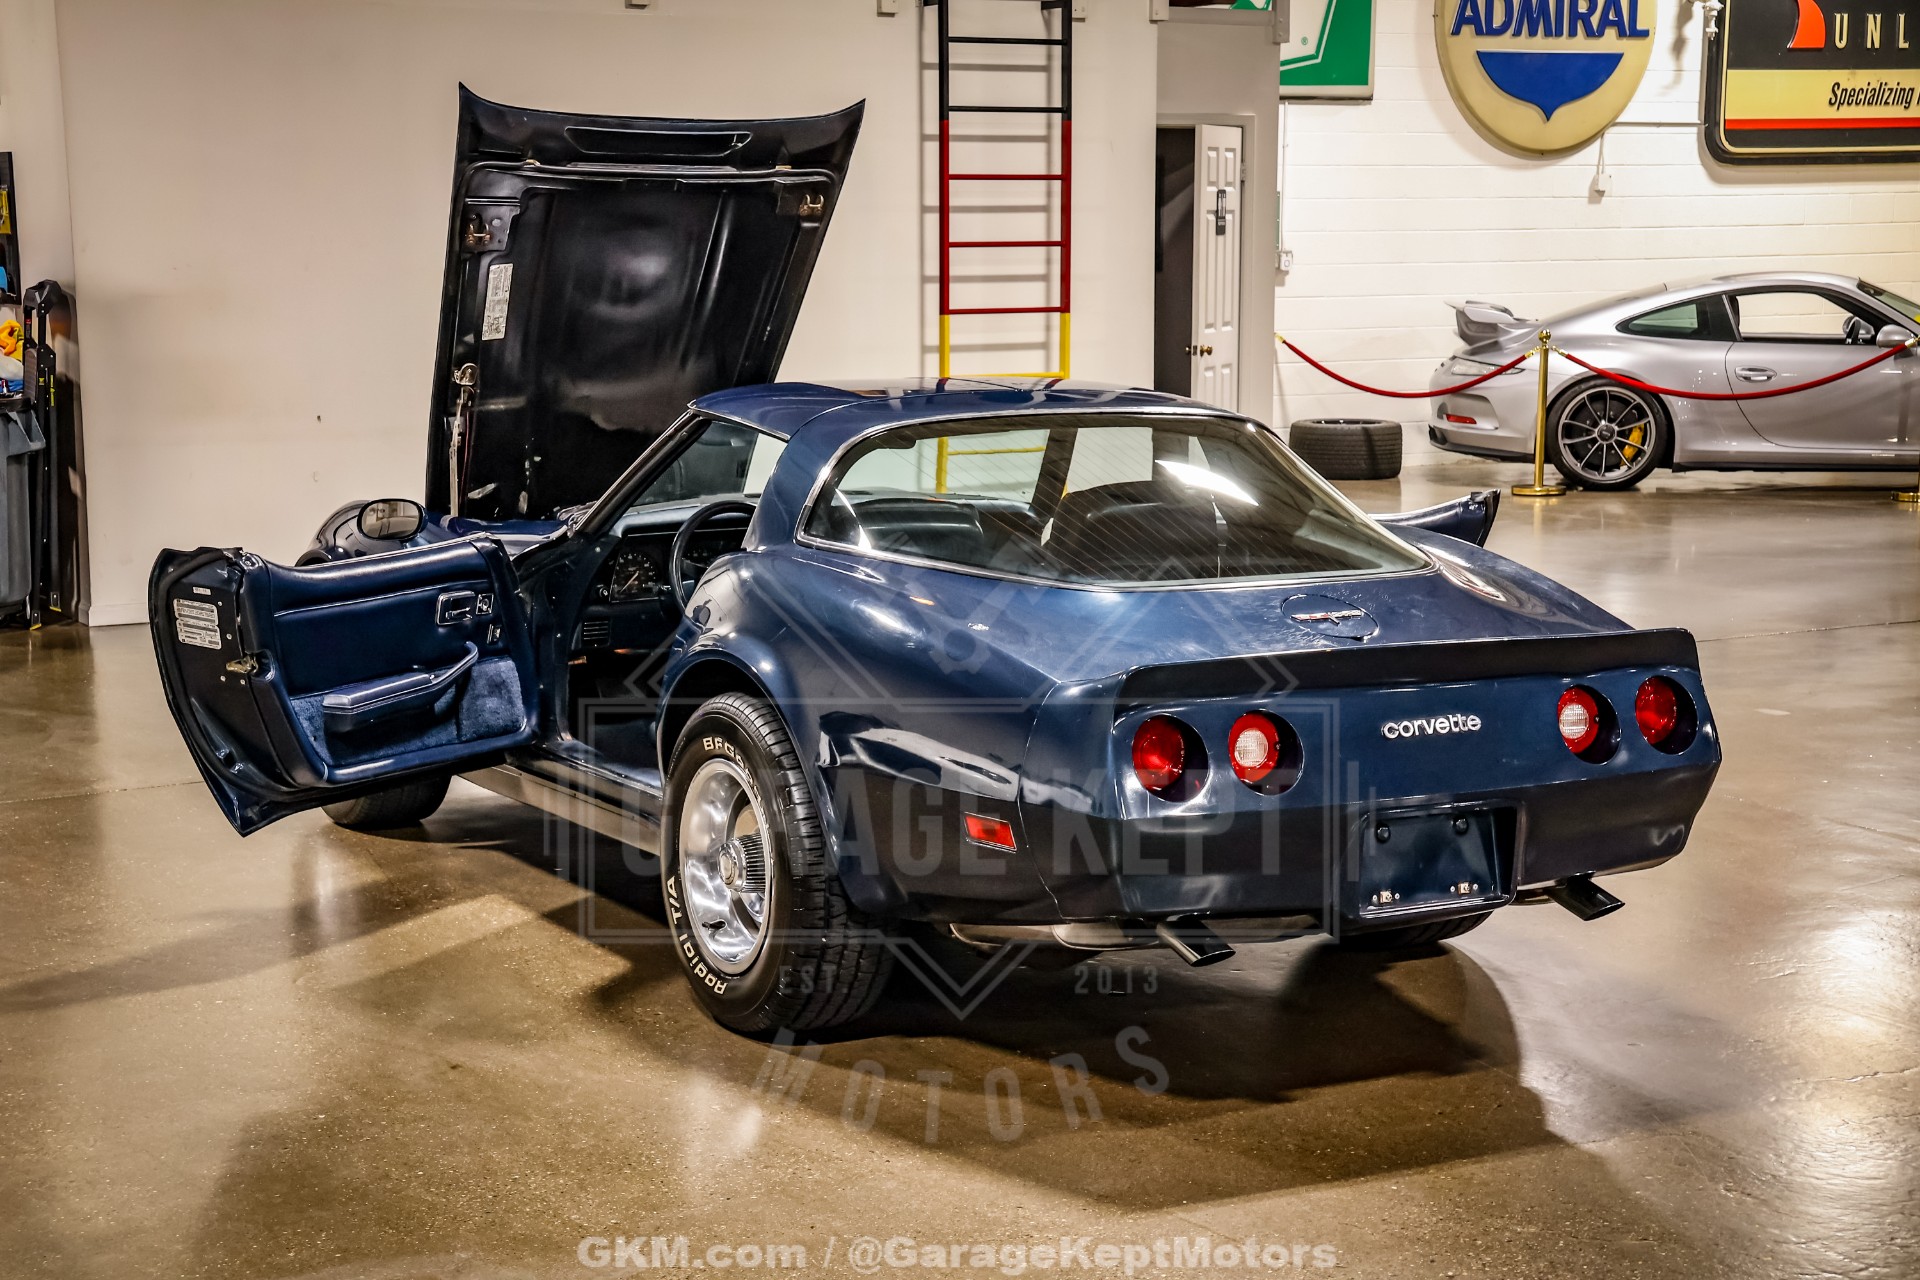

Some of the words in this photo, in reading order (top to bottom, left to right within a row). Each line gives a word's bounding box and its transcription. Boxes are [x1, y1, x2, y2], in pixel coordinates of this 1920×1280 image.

[1451, 0, 1649, 37] ADMIRAL
[1829, 82, 1914, 109] Specializing
[1381, 713, 1481, 739] corvette
[666, 876, 684, 925] T/A
[679, 933, 728, 995] Radial
